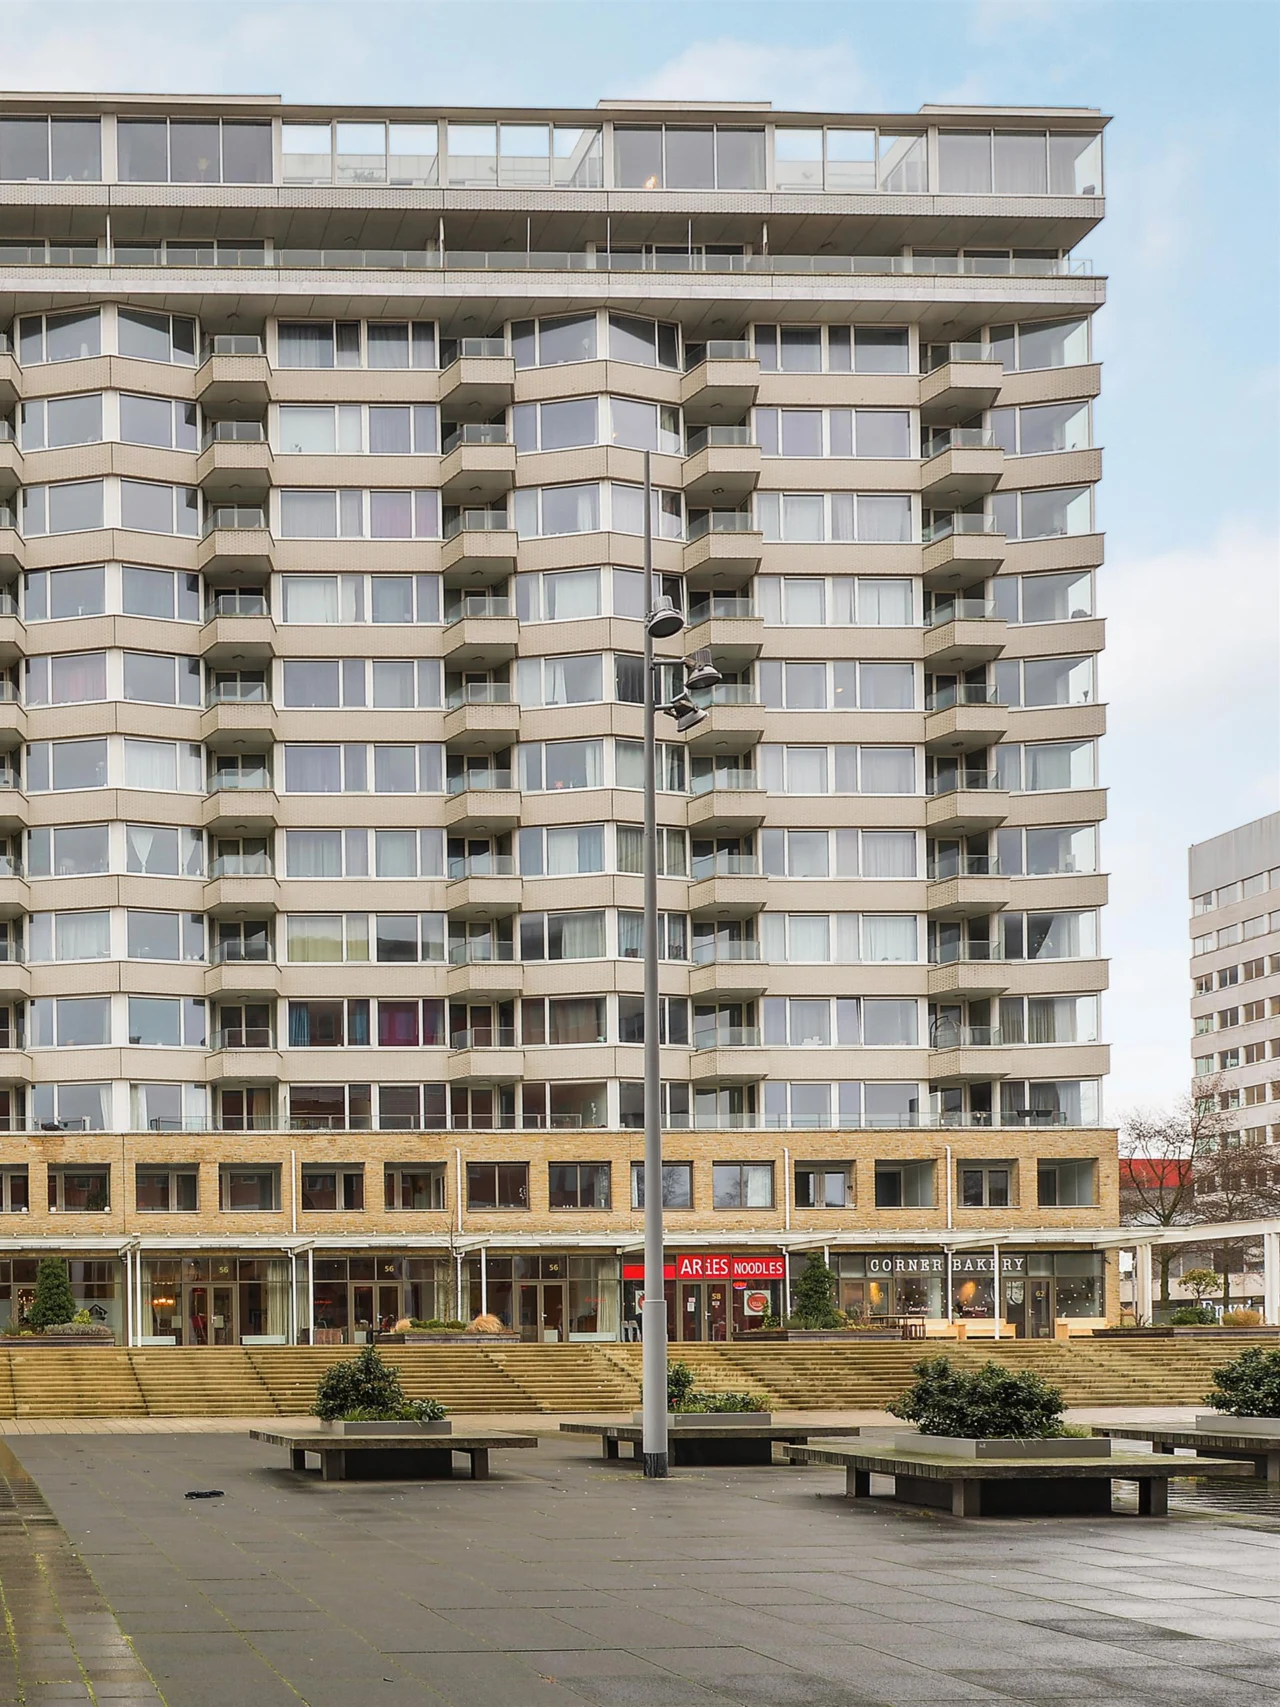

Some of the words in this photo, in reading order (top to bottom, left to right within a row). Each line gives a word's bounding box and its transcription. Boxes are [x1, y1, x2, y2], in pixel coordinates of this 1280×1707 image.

[734, 1262, 783, 1274] NOODLES
[870, 1259, 942, 1272] CORNER
[952, 1258, 1024, 1271] BAKERY
